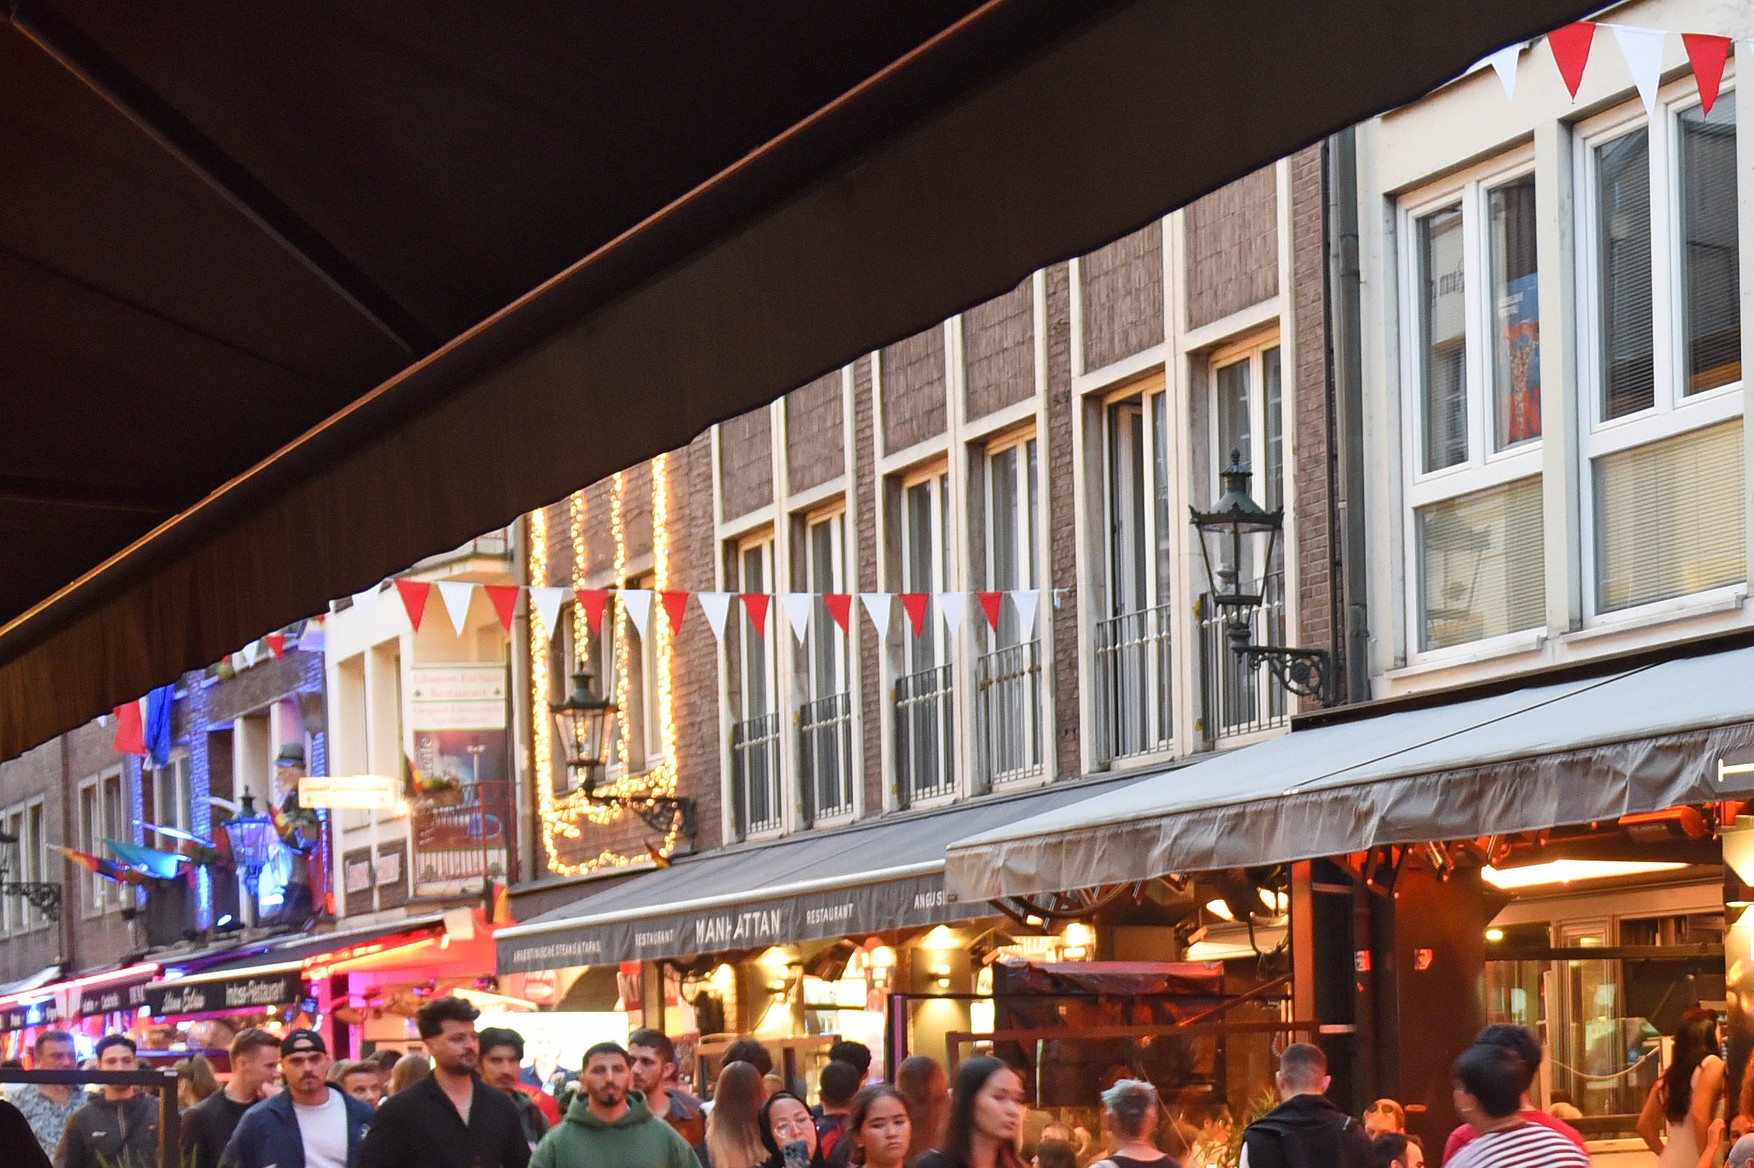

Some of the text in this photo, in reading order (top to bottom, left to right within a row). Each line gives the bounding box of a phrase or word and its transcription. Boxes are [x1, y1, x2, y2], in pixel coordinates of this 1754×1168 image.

[913, 889, 946, 910] ANGUS
[806, 903, 854, 926] RESTAURANT
[635, 929, 673, 947] RESTAURANT
